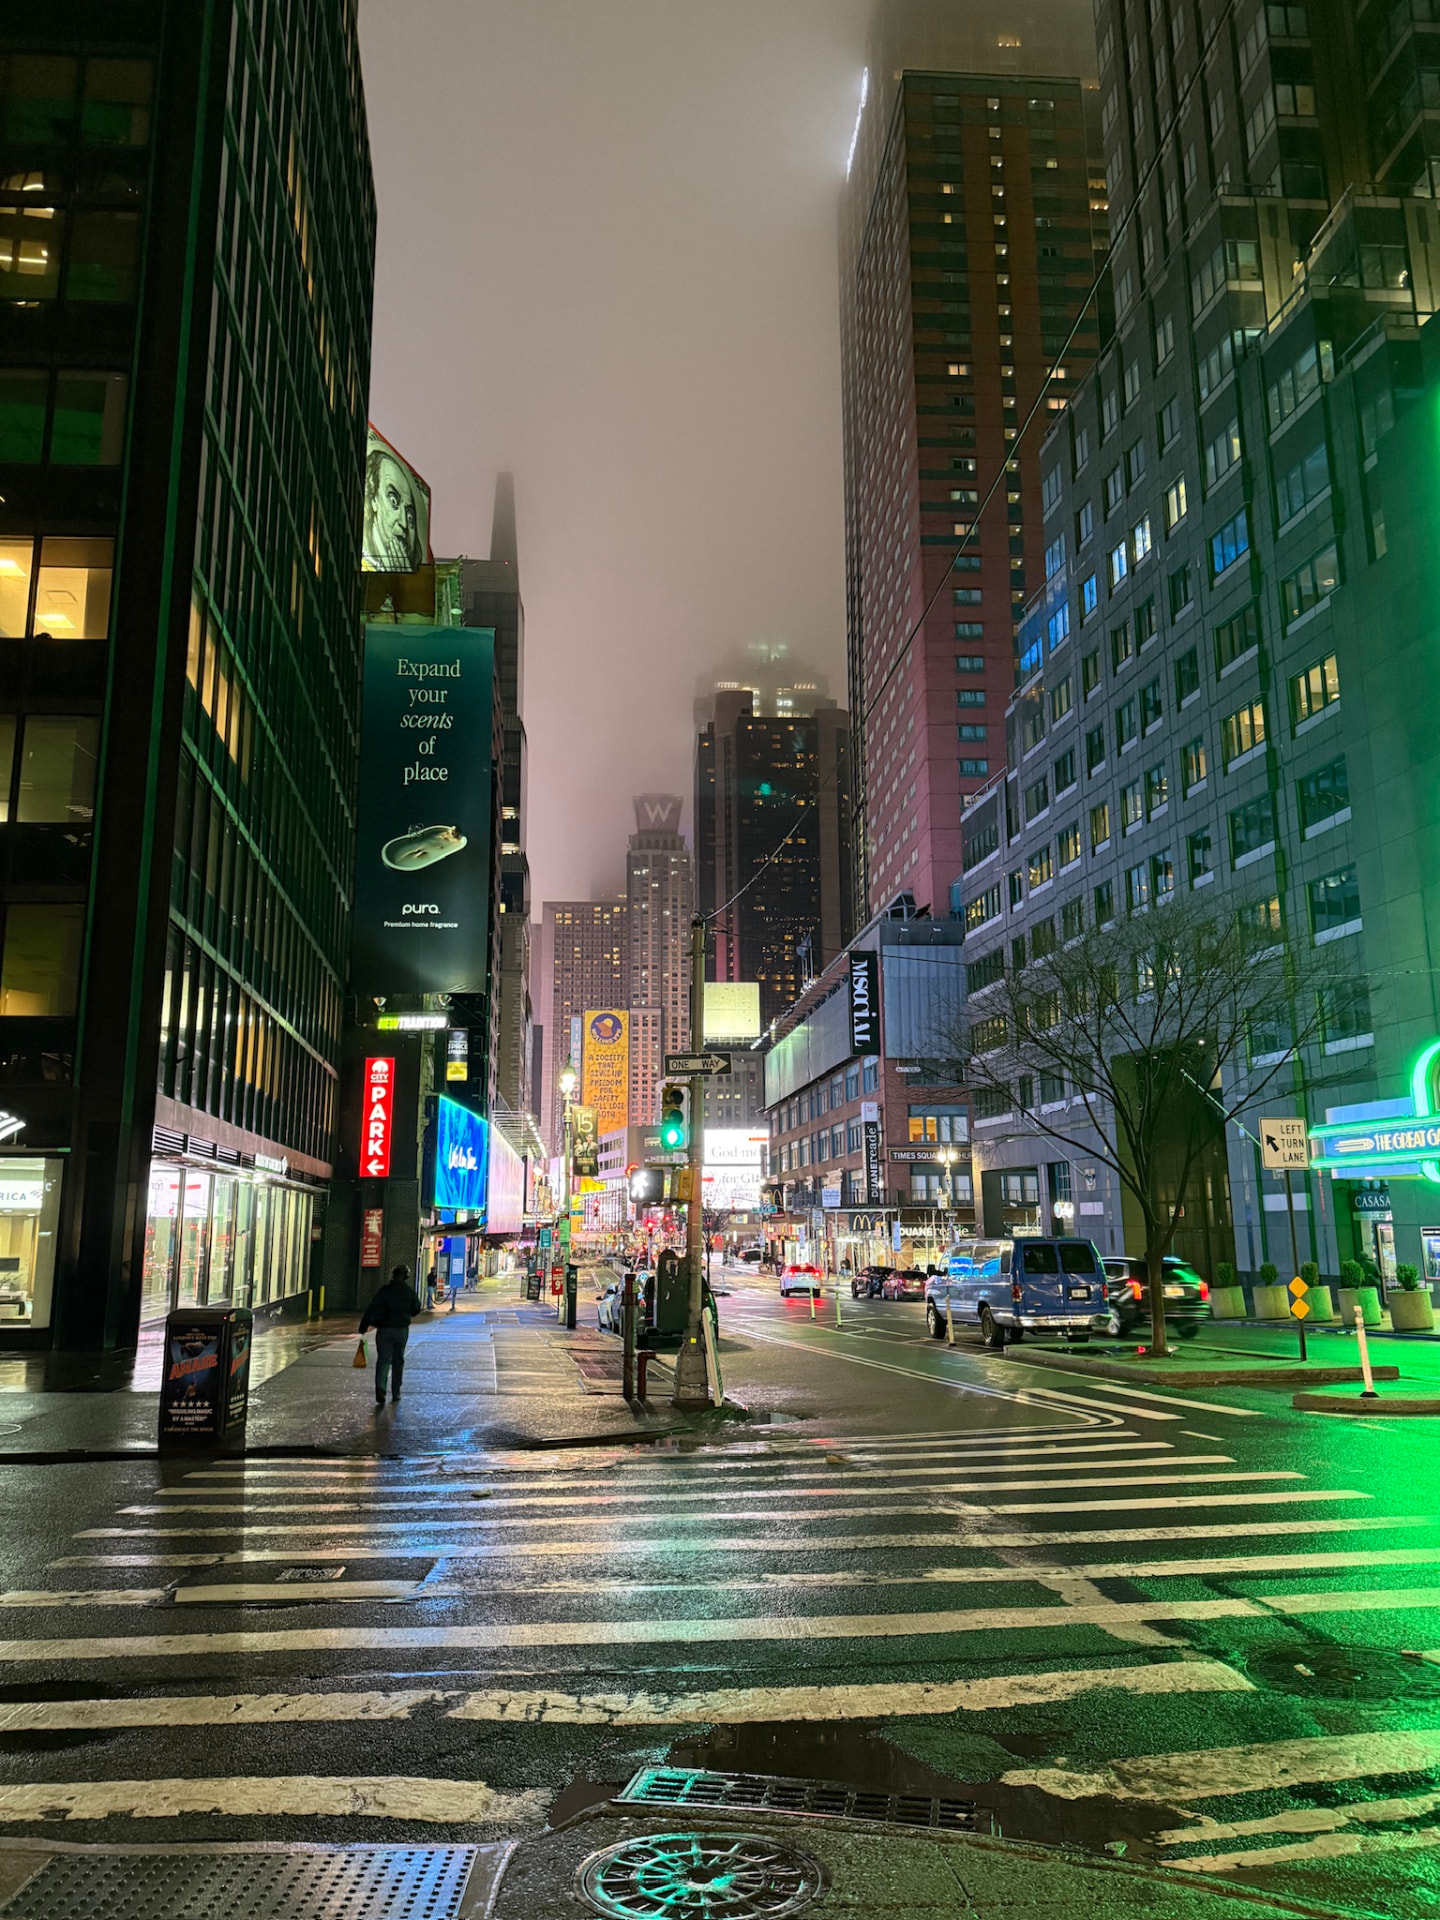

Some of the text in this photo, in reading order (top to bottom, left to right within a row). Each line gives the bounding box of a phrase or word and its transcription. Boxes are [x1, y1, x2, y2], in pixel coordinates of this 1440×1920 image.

[396, 658, 461, 681] Expand
[409, 689, 447, 706] your
[400, 712, 453, 729] scents
[419, 736, 435, 755] of
[403, 761, 448, 785] place
[644, 802, 673, 823] W
[430, 921, 458, 929] fragrance
[672, 1060, 720, 1070] ONE WAY
[369, 1087, 386, 1155] PARK
[1281, 1125, 1302, 1134] LEFT
[1281, 1138, 1304, 1148] TURN
[1374, 1133, 1393, 1151] THE
[1392, 1130, 1425, 1149] GREAT
[711, 1146, 738, 1158] God
[893, 1152, 915, 1160] TIMES
[1283, 1152, 1305, 1162] LANE
